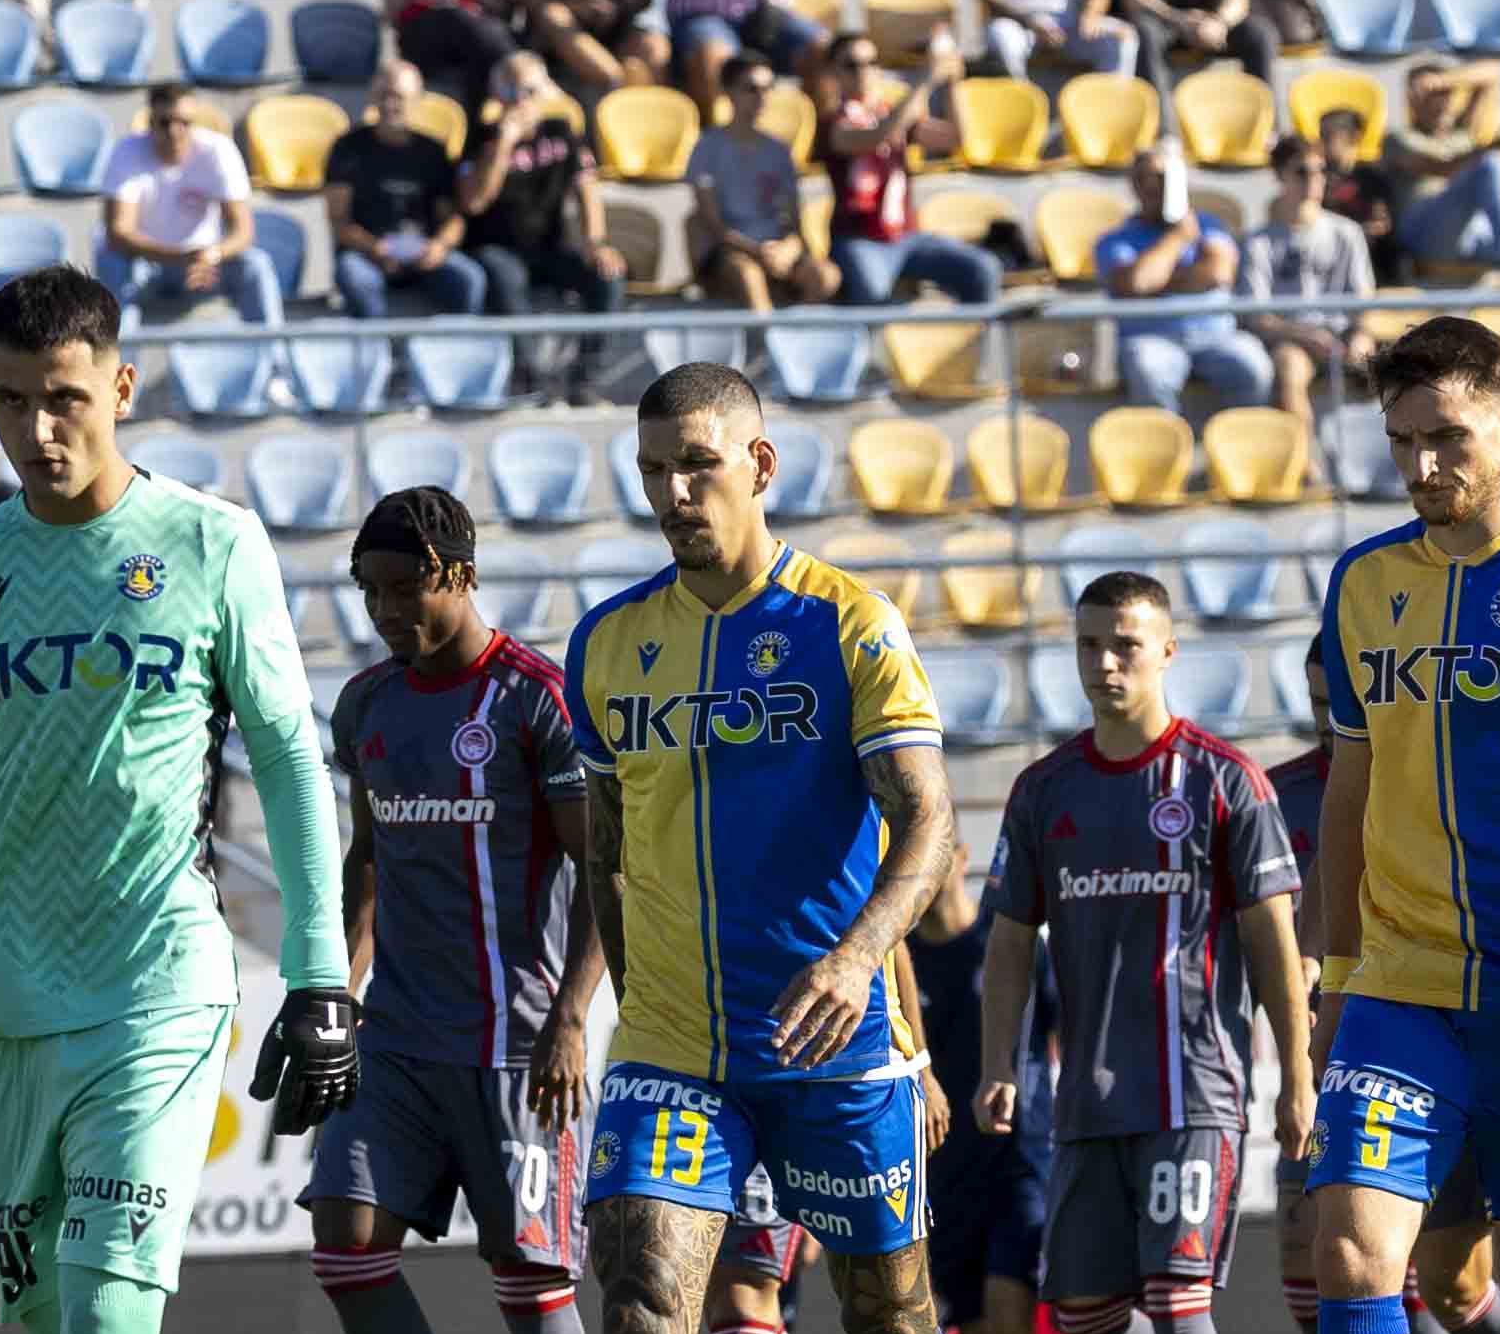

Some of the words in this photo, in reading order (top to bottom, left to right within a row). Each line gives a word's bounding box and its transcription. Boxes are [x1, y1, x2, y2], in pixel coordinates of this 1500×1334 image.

[649, 1106, 709, 1187] 13
[1359, 1098, 1397, 1171] 5
[784, 1157, 912, 1200] badounas
[1149, 1159, 1213, 1225] 80
